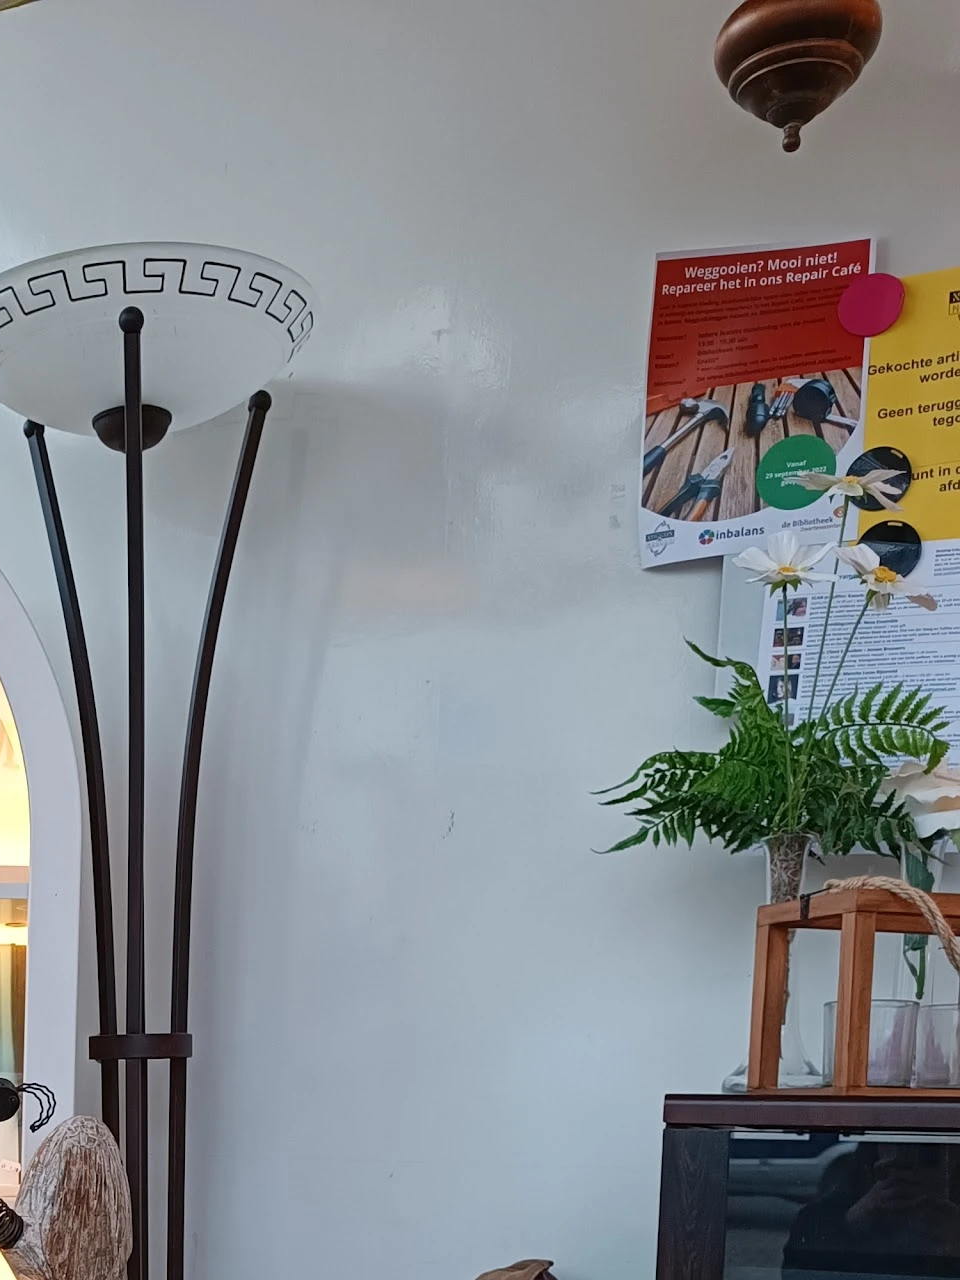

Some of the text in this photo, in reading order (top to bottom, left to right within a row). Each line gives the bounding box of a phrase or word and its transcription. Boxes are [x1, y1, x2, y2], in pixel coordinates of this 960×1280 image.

[684, 251, 838, 280] Weggooien? Mooi niet!
[661, 262, 862, 298] Repareer het in ons Repair Café
[868, 358, 933, 376] Gekochte
[936, 351, 960, 365] arti
[919, 367, 960, 384] worde
[877, 407, 914, 419] Geen
[786, 460, 807, 468] Vanaf
[938, 466, 951, 477] in
[715, 526, 765, 541] inbalans
